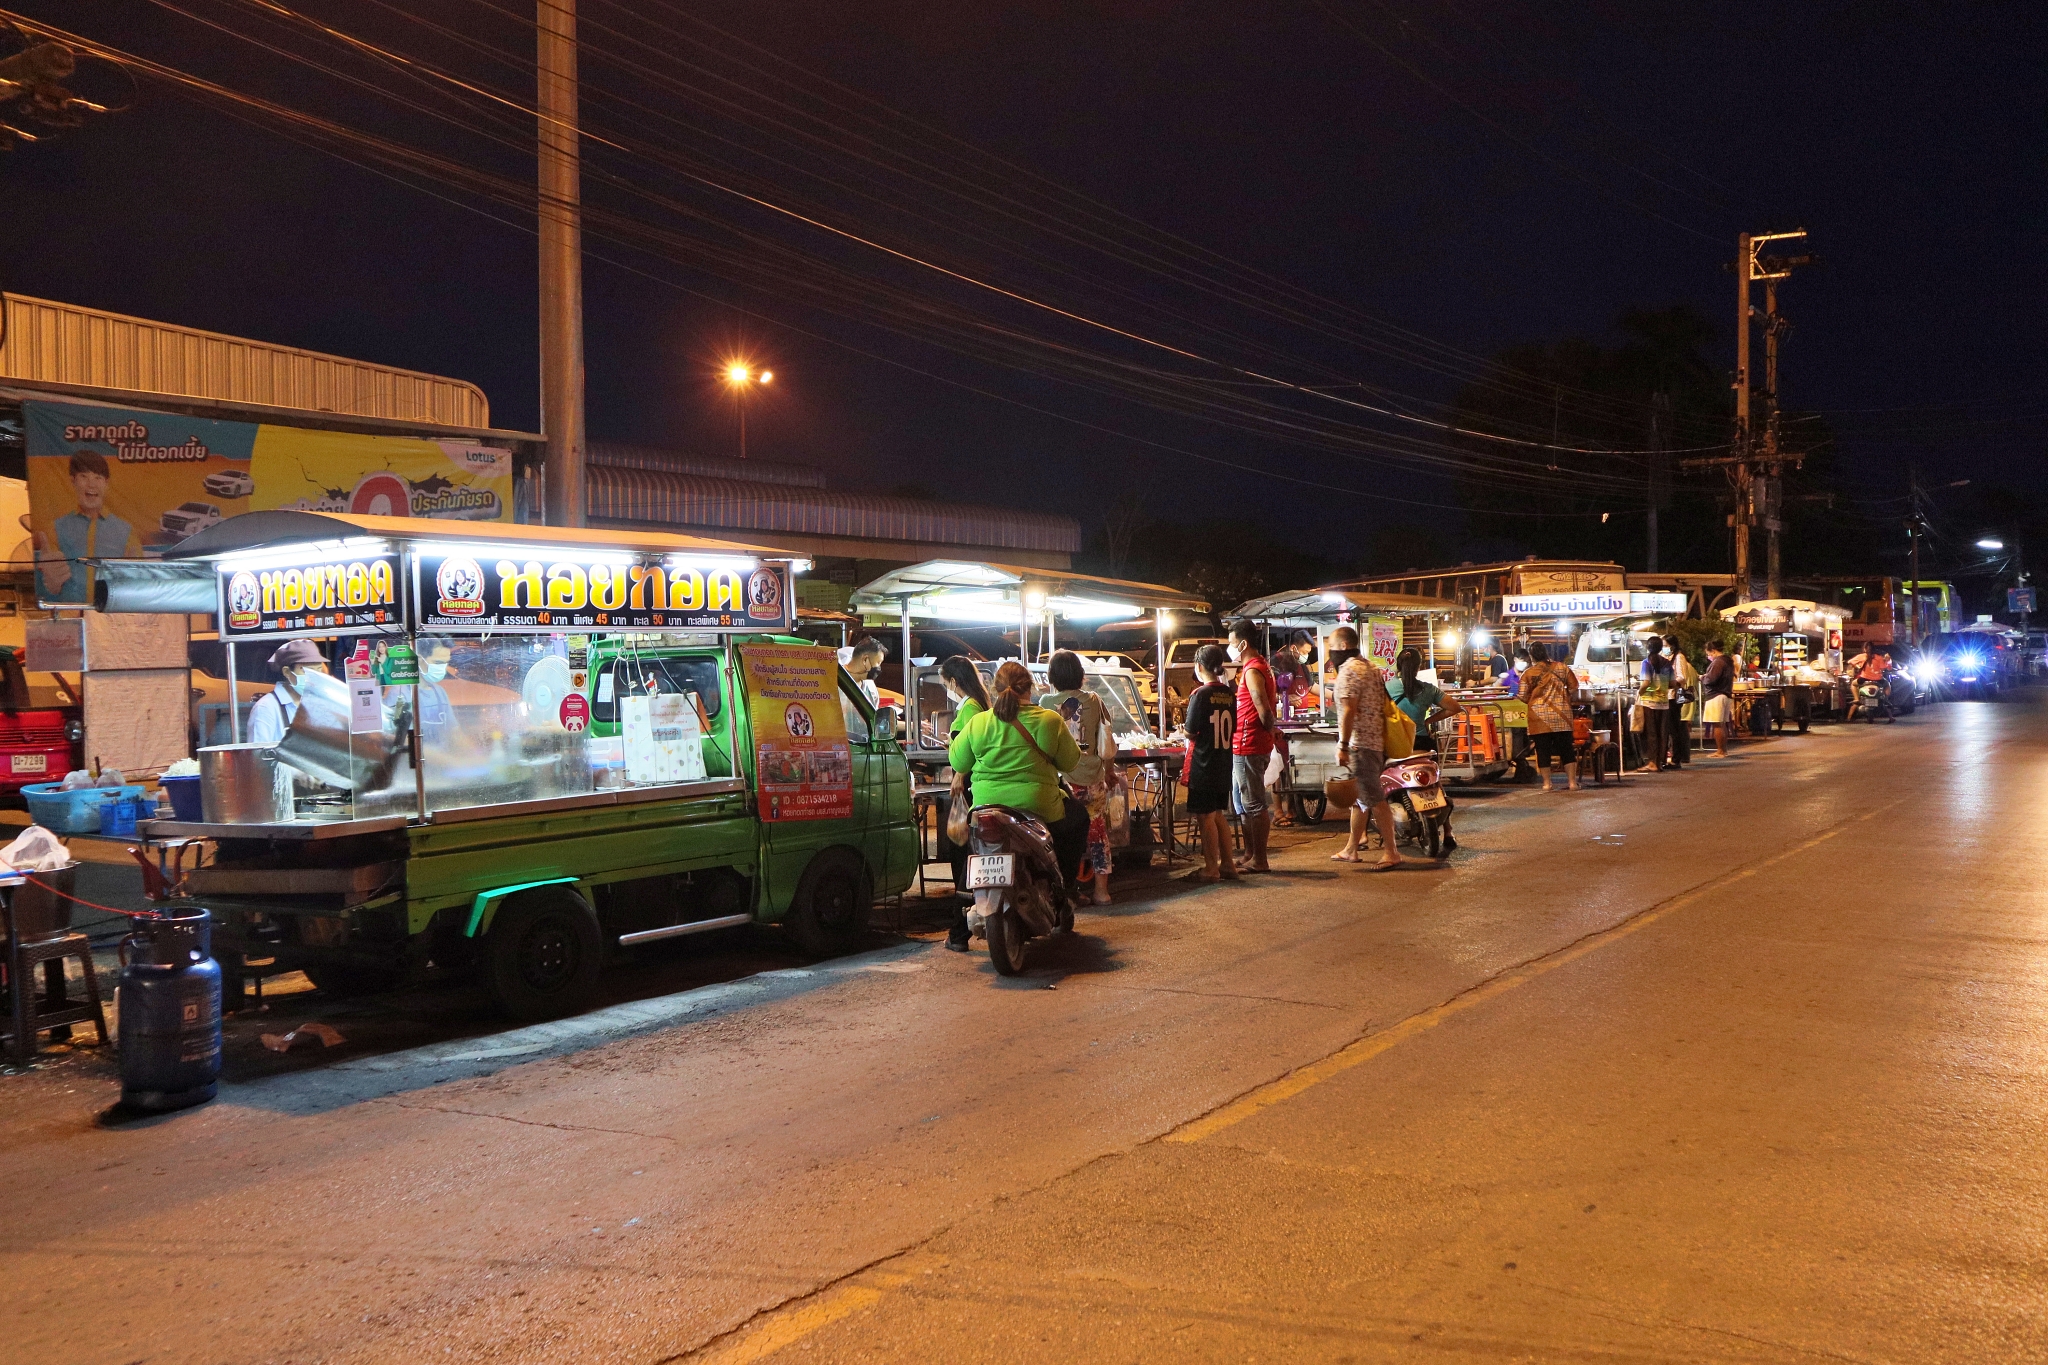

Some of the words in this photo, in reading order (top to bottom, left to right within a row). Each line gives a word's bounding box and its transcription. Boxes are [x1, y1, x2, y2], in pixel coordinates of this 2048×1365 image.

[65, 421, 146, 444] ราคาถูกใจ
[117, 436, 206, 460] ไม่มีดอกเบี้ย
[411, 489, 493, 512] ประกันภัยรถ
[260, 559, 395, 614] หอยทอด
[496, 559, 744, 611] หอยทอด
[441, 600, 480, 609] หอยทอด
[1509, 595, 1623, 613] ขนมจีน-บ้านโป่ง
[277, 618, 286, 629] 40
[305, 615, 315, 626] 45
[335, 613, 344, 625] 50
[375, 611, 385, 623] 55
[503, 615, 537, 625] ธรรมดา
[538, 612, 550, 624] 40
[552, 615, 567, 625] บาท
[573, 614, 593, 625] พิเศษ
[596, 613, 608, 625] 45
[612, 616, 627, 625] บาท
[634, 617, 649, 626] ทะเล
[653, 614, 664, 625] 50
[668, 617, 682, 626] บาท
[687, 615, 719, 626] ทะเลพิเศษ
[720, 614, 731, 625] 55
[732, 617, 745, 626] บาท
[1373, 639, 1398, 665] หมู
[1210, 709, 1233, 749] 10
[783, 796, 790, 805] ID
[796, 794, 838, 805] 0871534218
[980, 856, 1004, 866] 1กก
[978, 866, 1004, 875] กาญจนบุรี
[975, 875, 1006, 885] 3210
